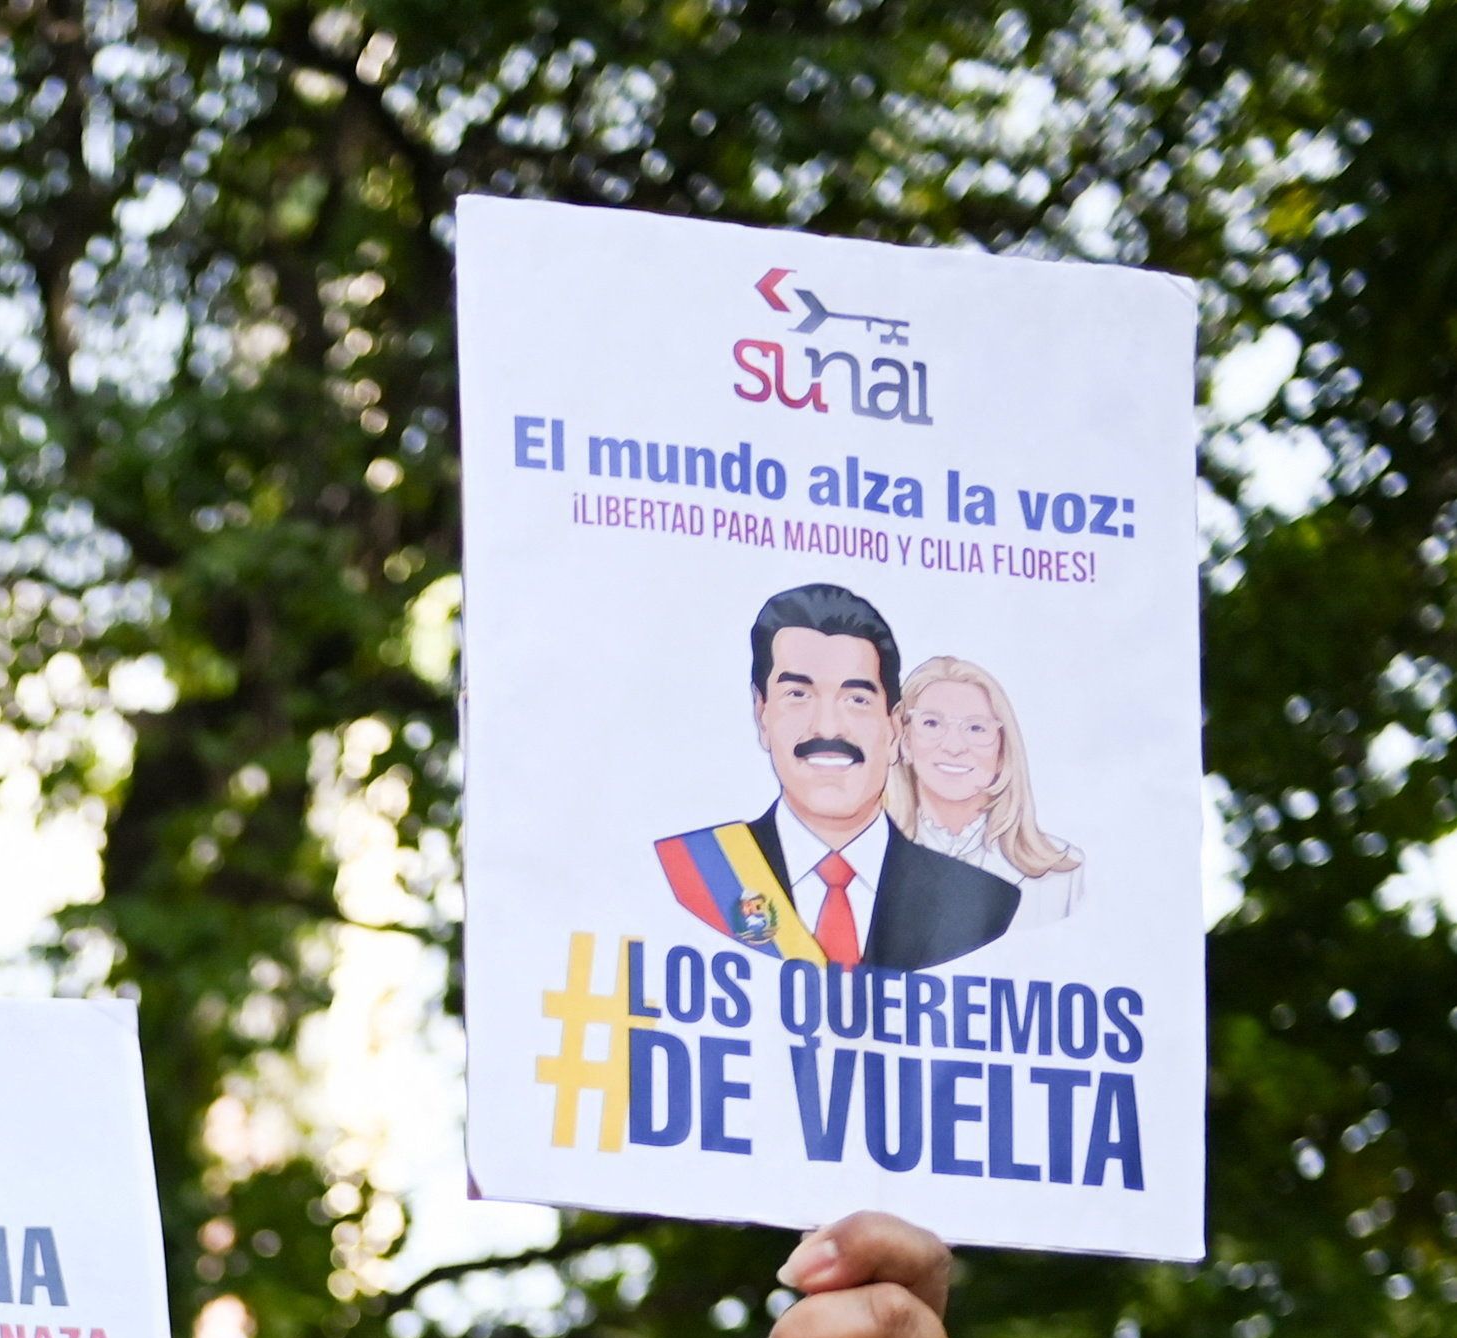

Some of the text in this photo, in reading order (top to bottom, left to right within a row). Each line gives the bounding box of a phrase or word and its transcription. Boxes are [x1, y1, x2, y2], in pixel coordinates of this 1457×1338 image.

[514, 415, 1136, 539] El mundo alza la voz:
[572, 493, 1096, 583] ¡LIBERTAD PARA MADURO Y CILIA FLORES!
[780, 957, 1143, 1064] QUEREMOS
[628, 1026, 1145, 1191] DE VUELTA
